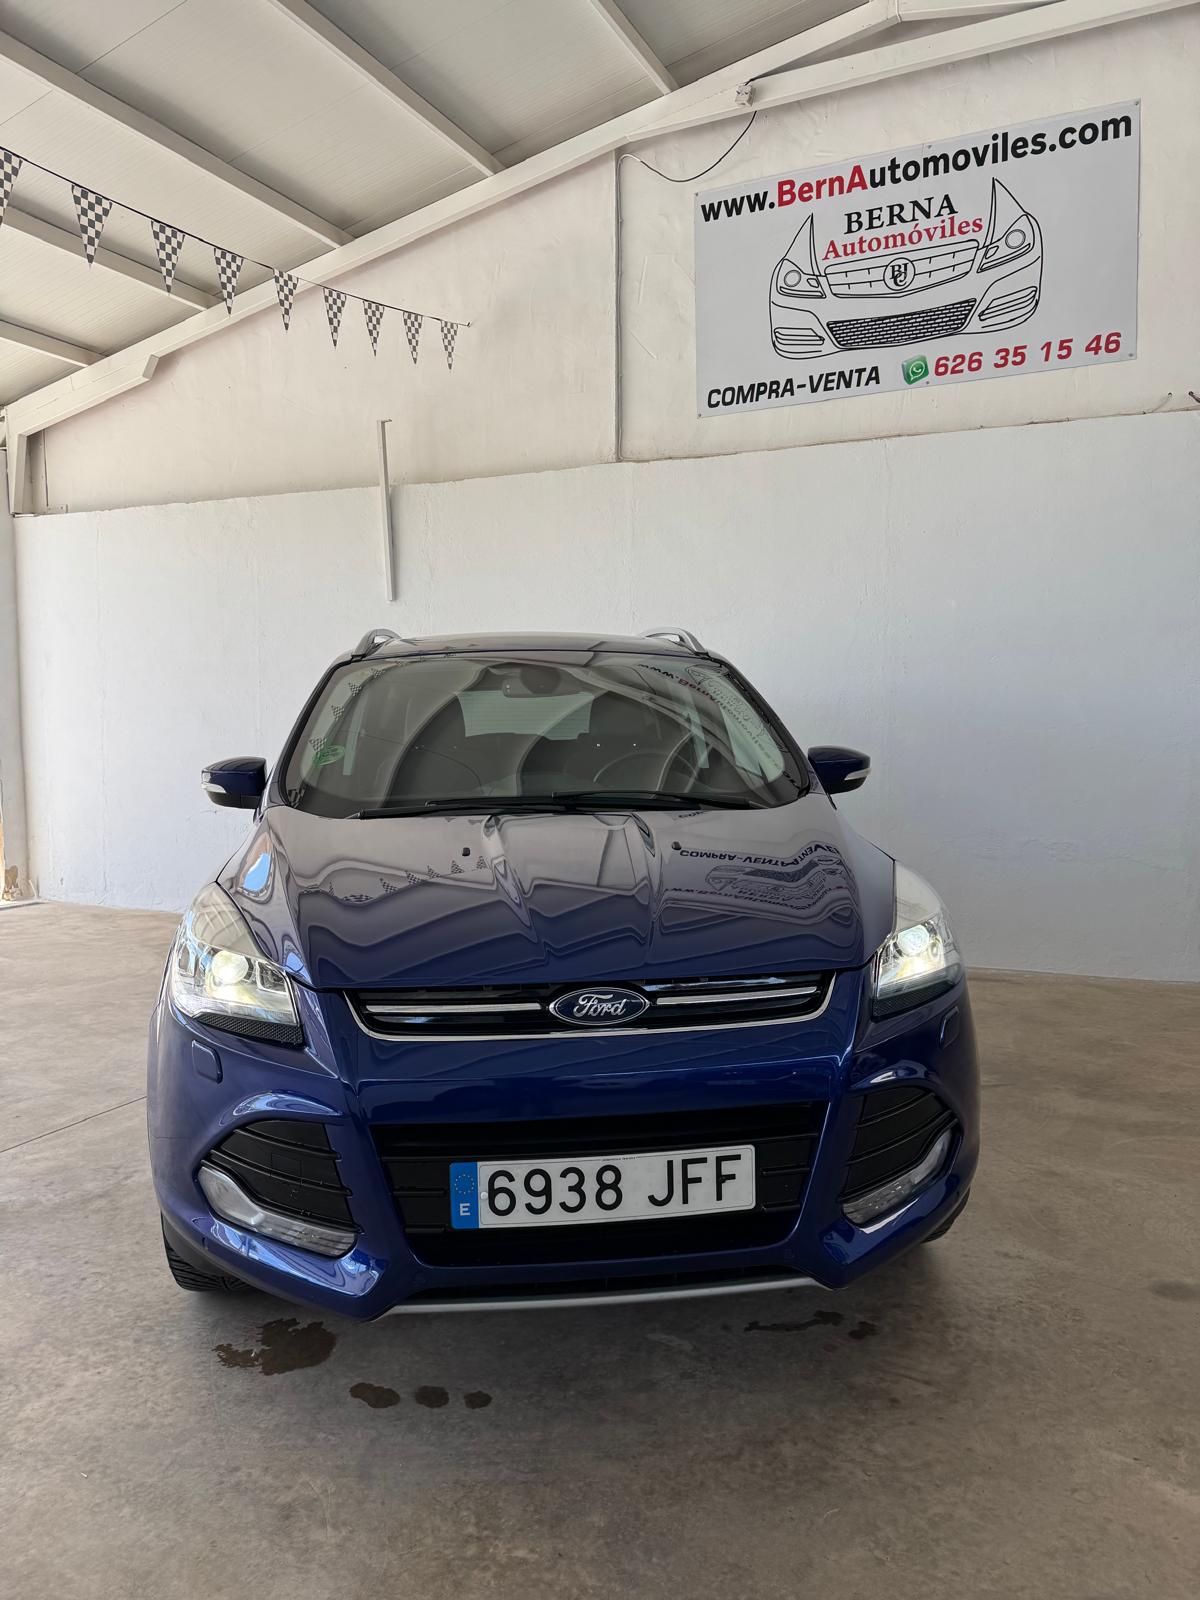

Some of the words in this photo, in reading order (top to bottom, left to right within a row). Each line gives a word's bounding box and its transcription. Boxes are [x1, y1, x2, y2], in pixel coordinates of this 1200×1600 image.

[700, 114, 1133, 223] www.BernAutomoviles.com
[844, 194, 958, 235] BERNA
[822, 215, 983, 261] Automóviles
[934, 351, 983, 377] 626
[993, 346, 1026, 370] 35
[1039, 338, 1073, 363] 15
[1085, 332, 1121, 356] 46
[707, 365, 881, 410] COMPRA-VENTA
[573, 994, 627, 1018] Ford
[487, 1164, 623, 1217] 6938
[647, 1154, 742, 1208] JFF
[459, 1202, 471, 1217] E
